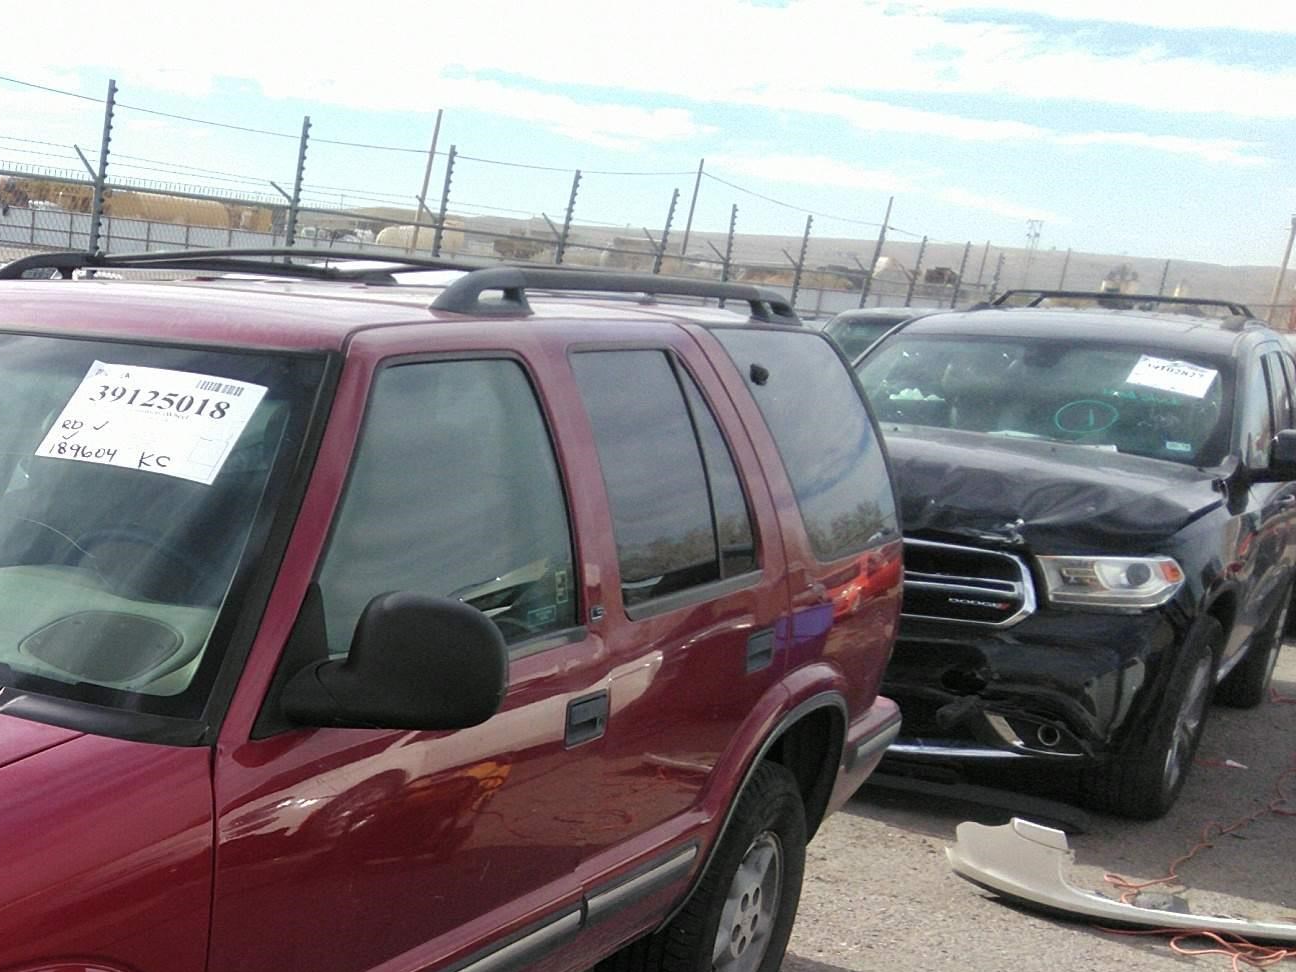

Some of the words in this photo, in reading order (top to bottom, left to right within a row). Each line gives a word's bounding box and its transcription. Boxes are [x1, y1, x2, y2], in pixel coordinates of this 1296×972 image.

[88, 385, 230, 420] 39125018
[49, 441, 118, 462] 189604
[137, 451, 171, 468] KC
